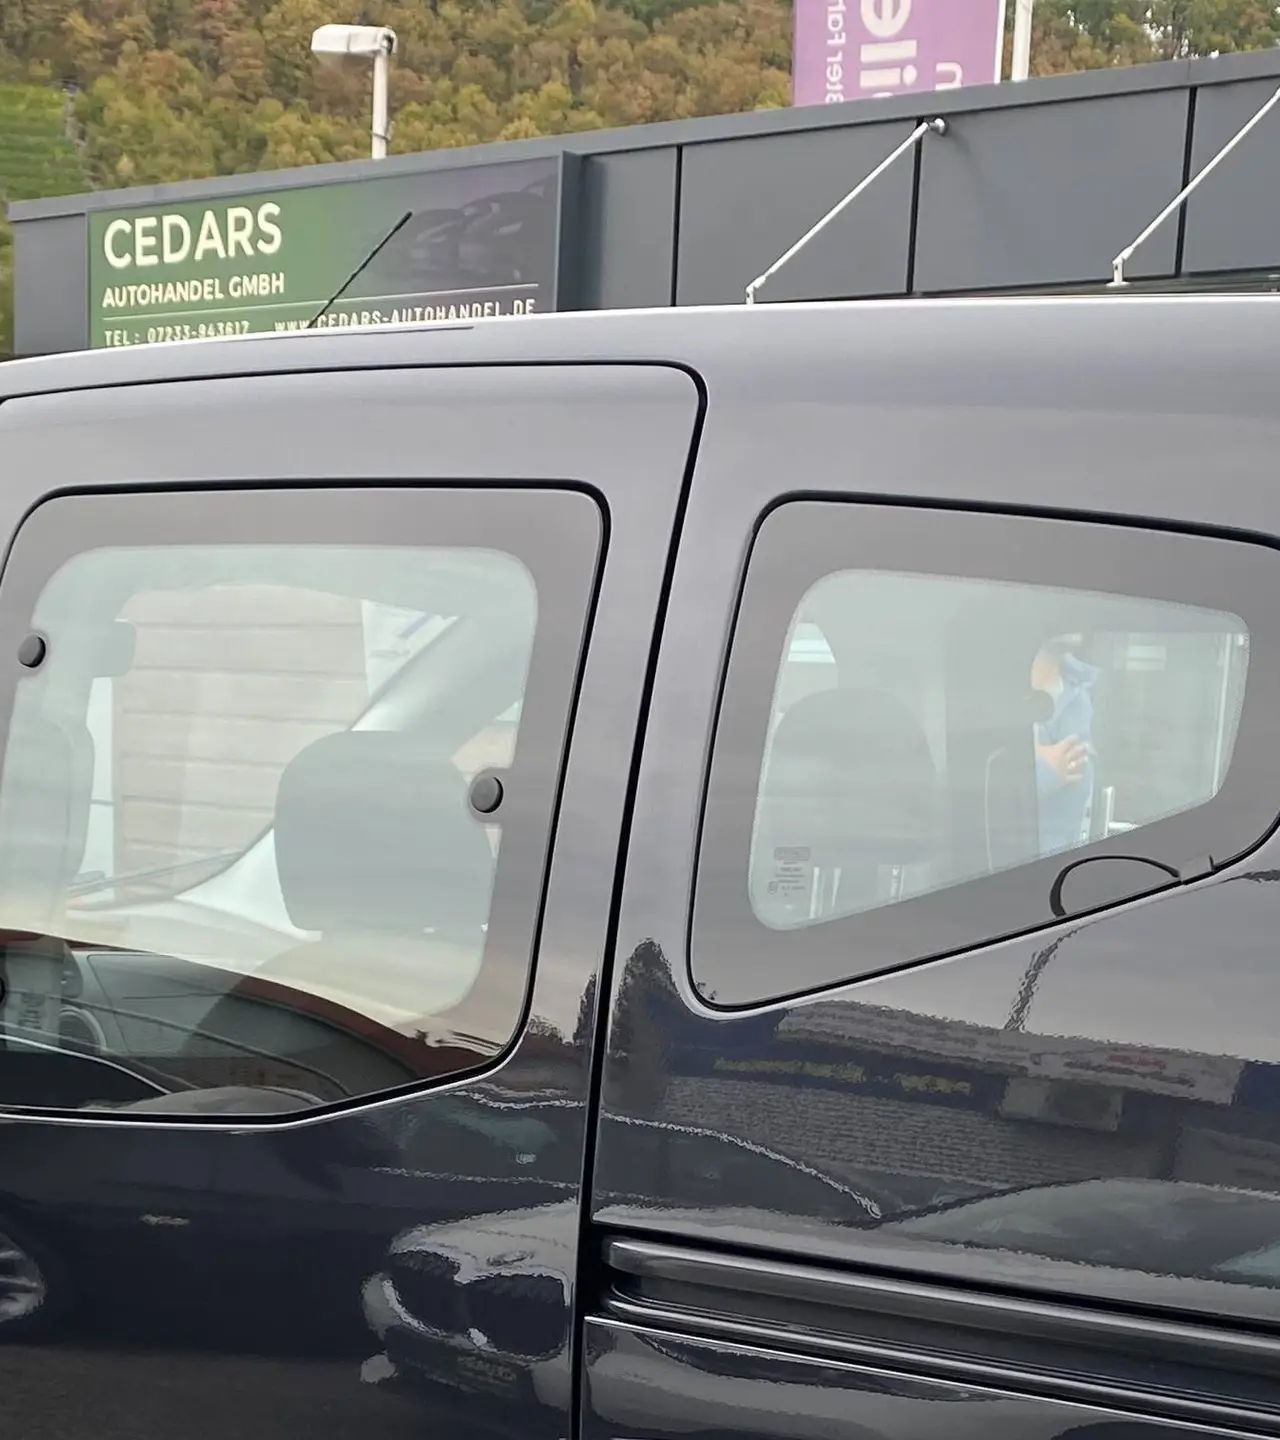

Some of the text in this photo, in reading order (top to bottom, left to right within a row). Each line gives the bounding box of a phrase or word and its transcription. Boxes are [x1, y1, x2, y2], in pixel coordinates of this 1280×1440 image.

[104, 202, 282, 269] CEDARS
[102, 271, 285, 308] AUTOHANDEL GMBH
